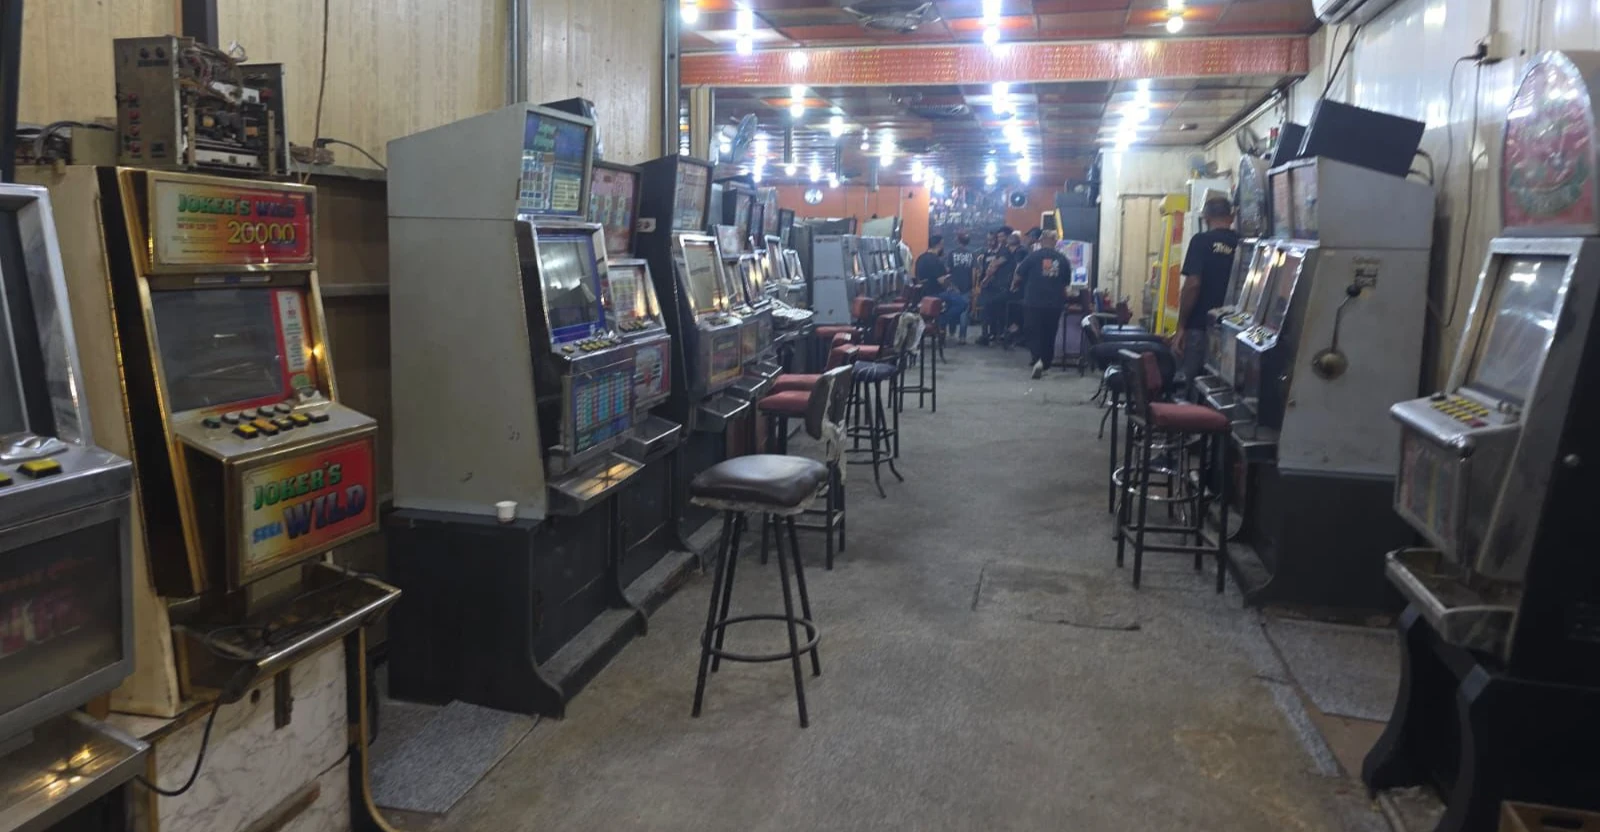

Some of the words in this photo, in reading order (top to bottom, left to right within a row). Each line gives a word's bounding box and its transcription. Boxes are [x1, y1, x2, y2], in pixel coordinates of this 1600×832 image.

[178, 195, 250, 215] JOKER'S
[228, 221, 295, 243] 20000
[254, 462, 342, 510] JOKER'S
[283, 485, 366, 539] WILD
